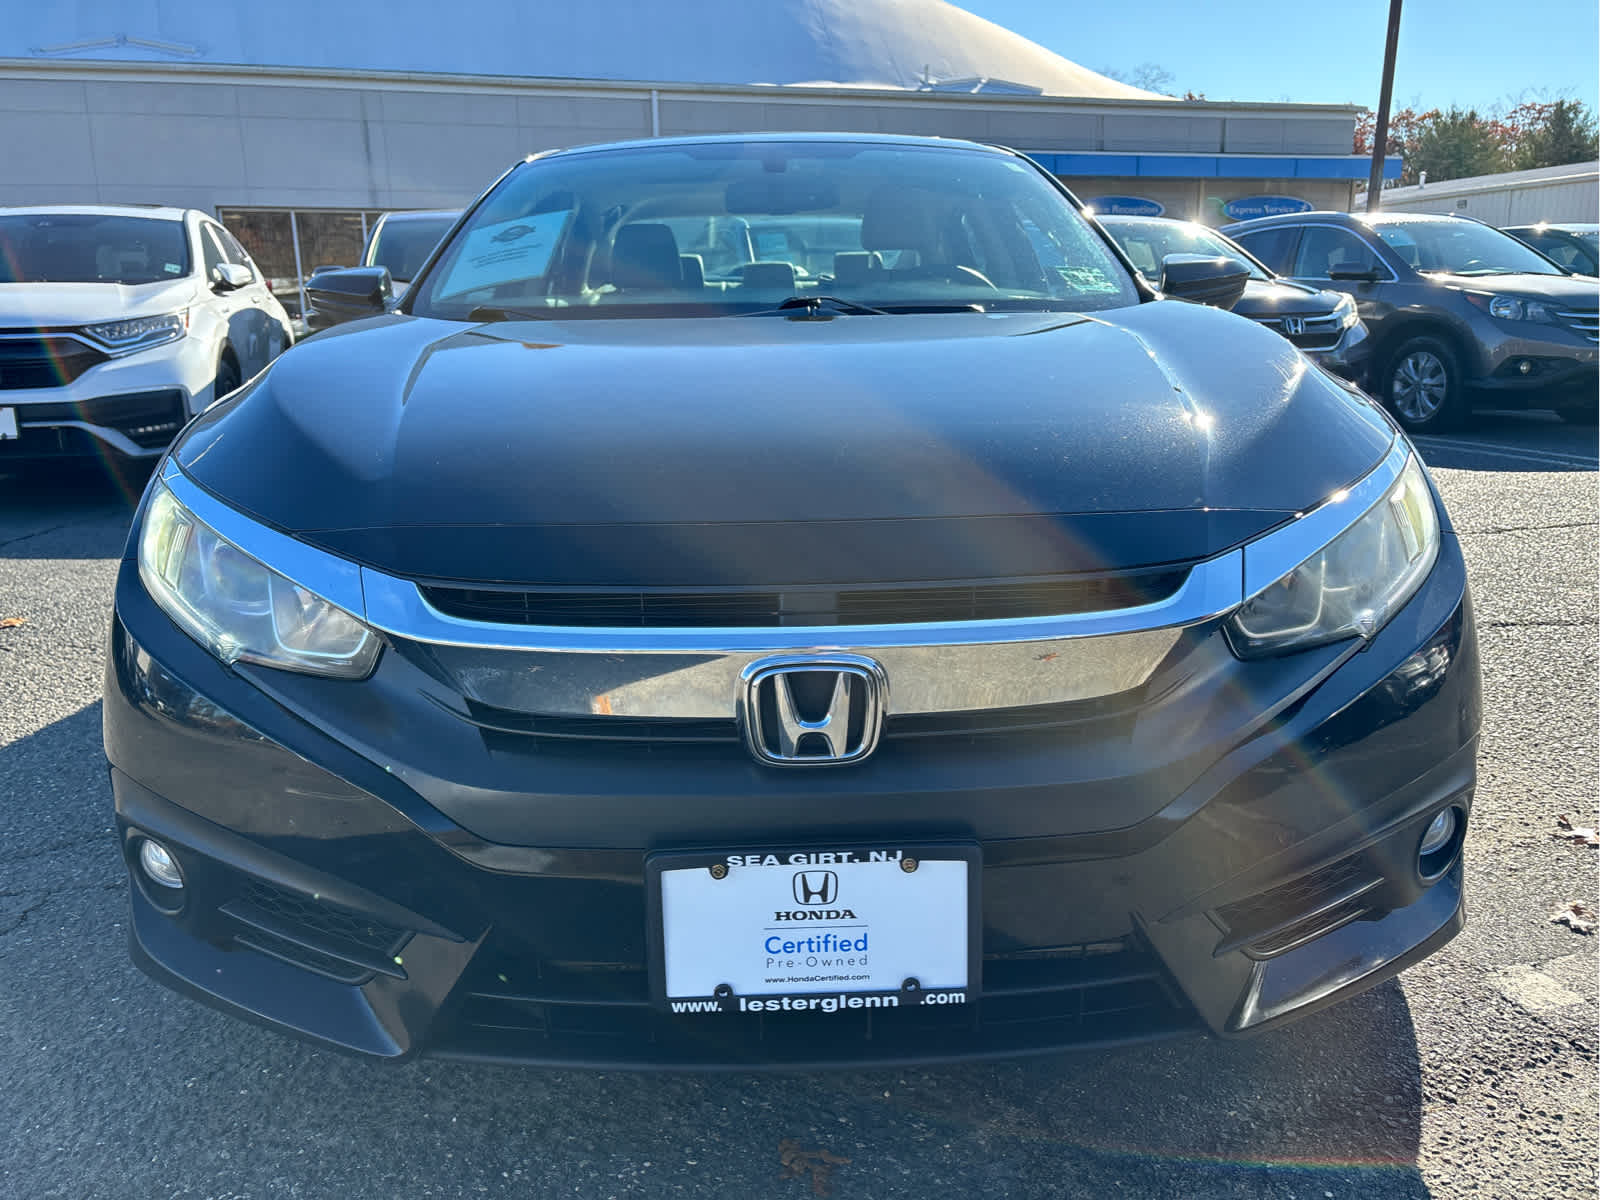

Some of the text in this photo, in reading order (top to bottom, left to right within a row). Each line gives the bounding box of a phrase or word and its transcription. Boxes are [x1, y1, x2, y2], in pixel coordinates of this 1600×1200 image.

[727, 854, 781, 867] SEA
[869, 850, 903, 862] NJ
[774, 909, 857, 921] HONDA
[764, 932, 868, 954] Certified
[766, 955, 868, 968] Pre-Owned
[764, 974, 870, 984] www.HondaCertified.com
[671, 992, 965, 1013] www. lesterglenn .com
